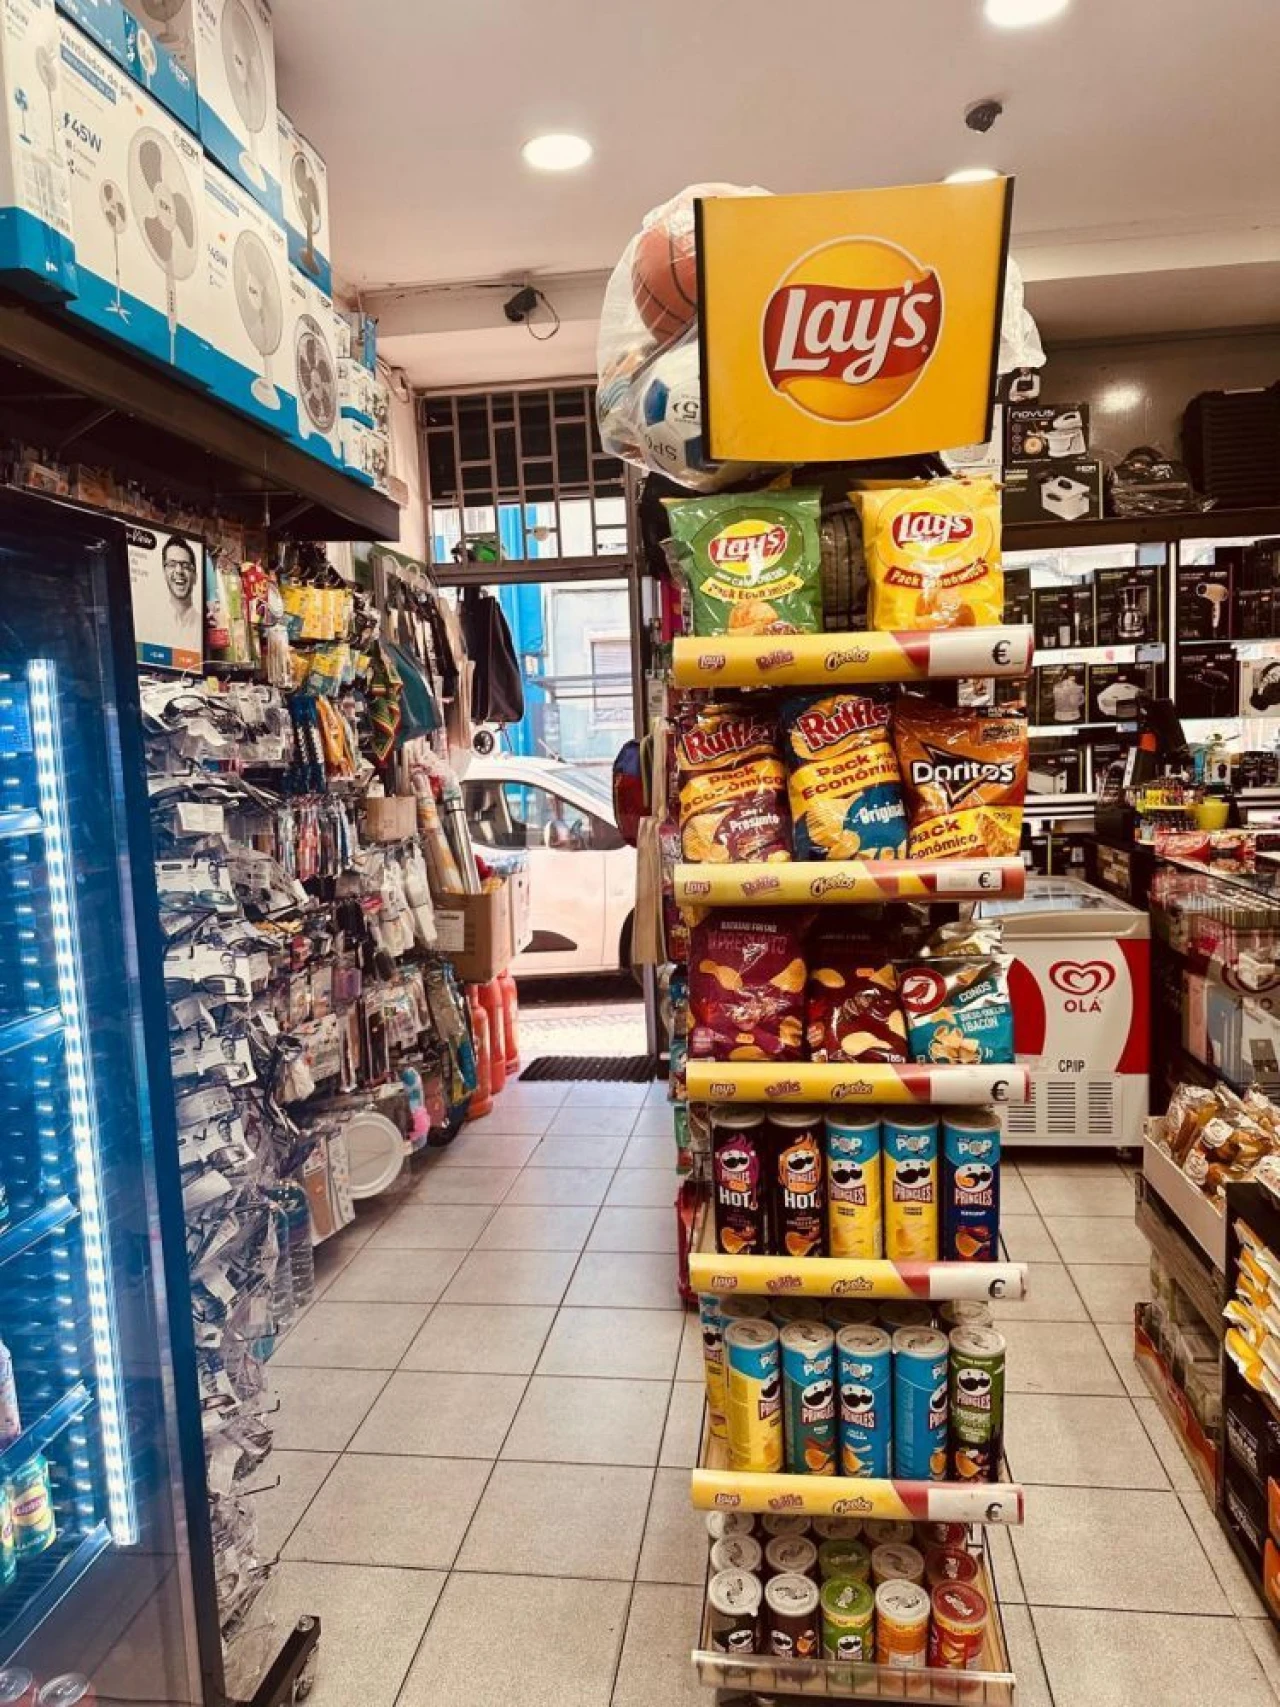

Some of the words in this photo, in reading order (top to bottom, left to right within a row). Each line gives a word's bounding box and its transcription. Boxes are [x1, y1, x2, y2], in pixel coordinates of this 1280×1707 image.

[71, 119, 102, 153] 45W
[773, 279, 933, 385] Lay's
[824, 645, 870, 671] Cheetos
[709, 766, 756, 785] Pack
[816, 754, 871, 777] Pack
[912, 761, 1014, 784] Doritos
[911, 833, 979, 860] conómico
[1064, 995, 1102, 1013] OLÁ
[896, 1136, 931, 1151] POP
[958, 1139, 993, 1155] POP
[719, 1185, 751, 1208] HOT
[784, 1189, 816, 1209] HOT
[894, 1181, 933, 1203] PRINGLES
[955, 1186, 993, 1206] PRINGLES
